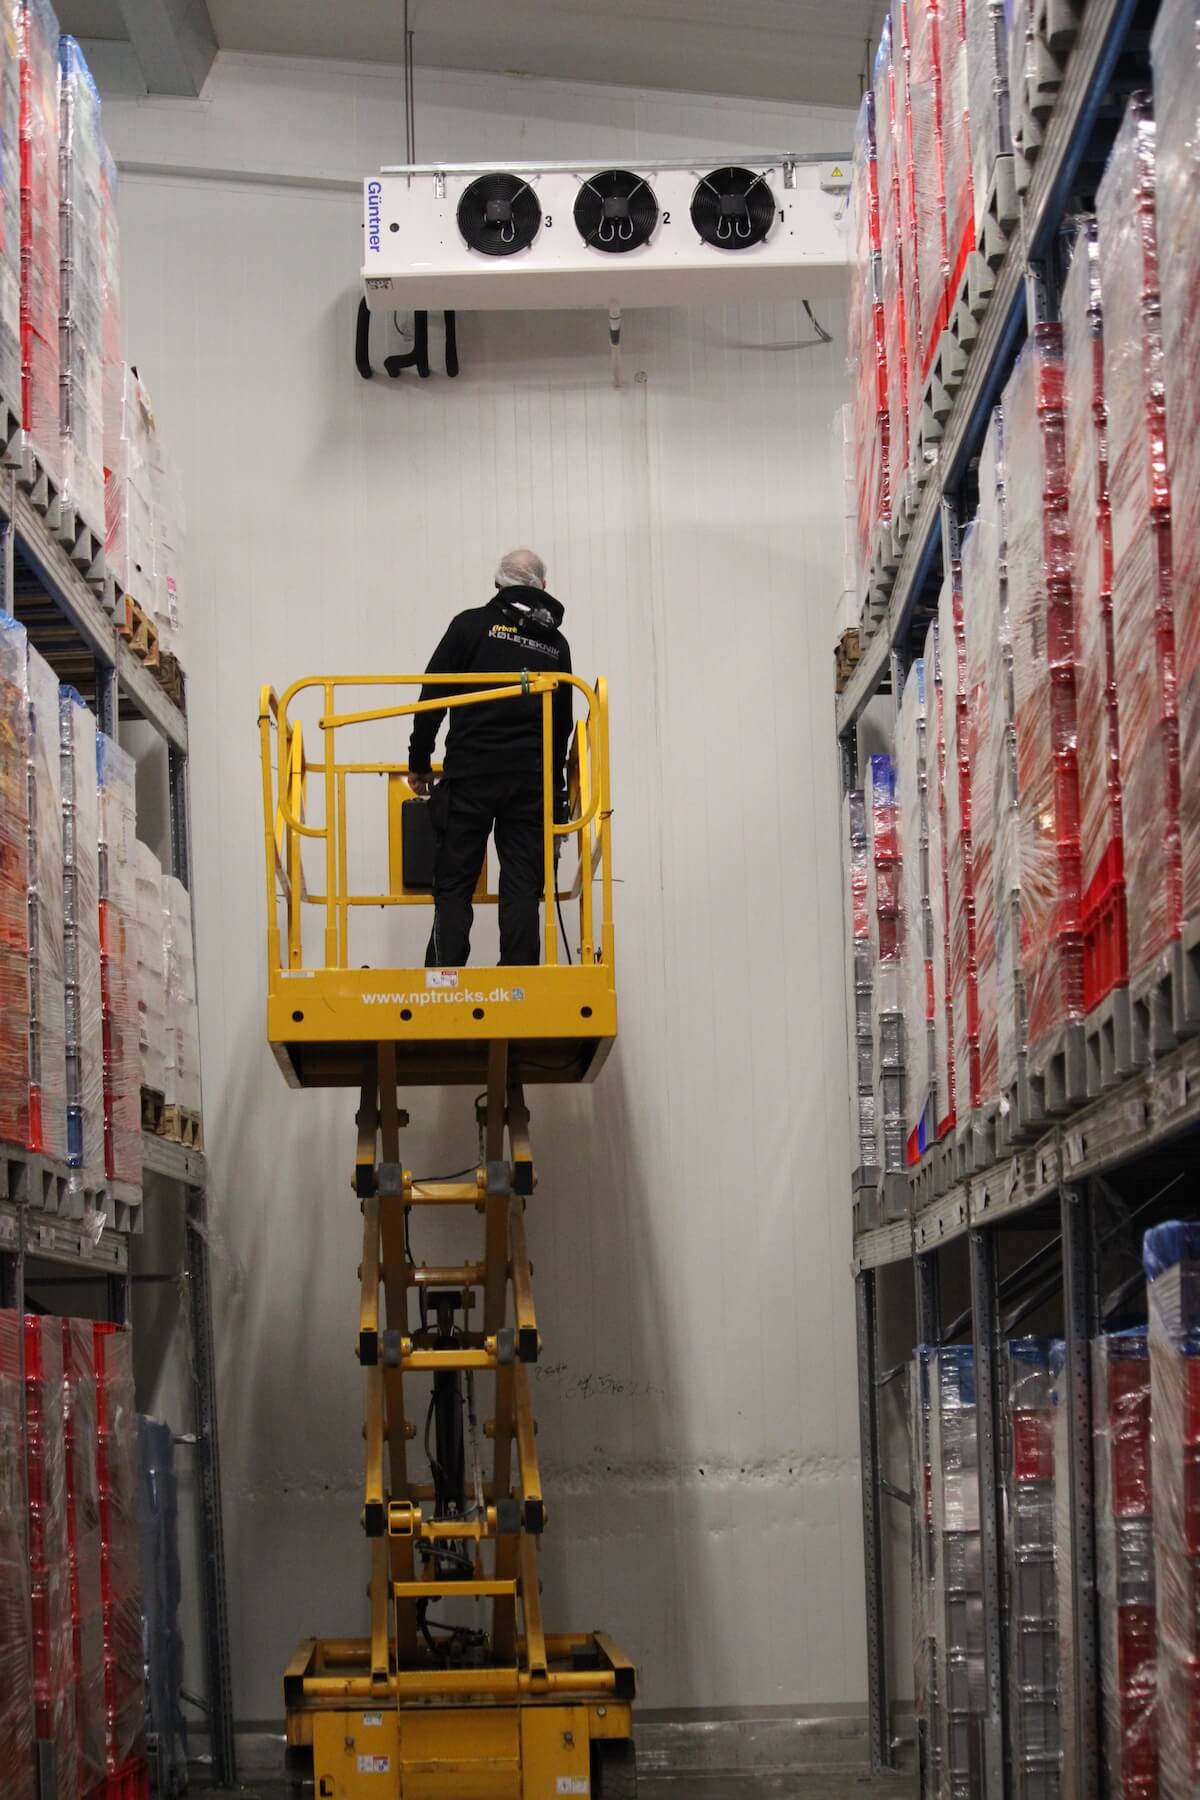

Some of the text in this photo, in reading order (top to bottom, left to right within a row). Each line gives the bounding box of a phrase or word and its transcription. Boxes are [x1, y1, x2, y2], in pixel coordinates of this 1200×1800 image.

[368, 182, 382, 252] Güntner
[545, 216, 552, 228] 3
[662, 212, 671, 224] 2
[778, 210, 785, 222] 1
[488, 630, 560, 656] KØLETEKNIK
[362, 988, 510, 1005] www.nptrucks.dk
